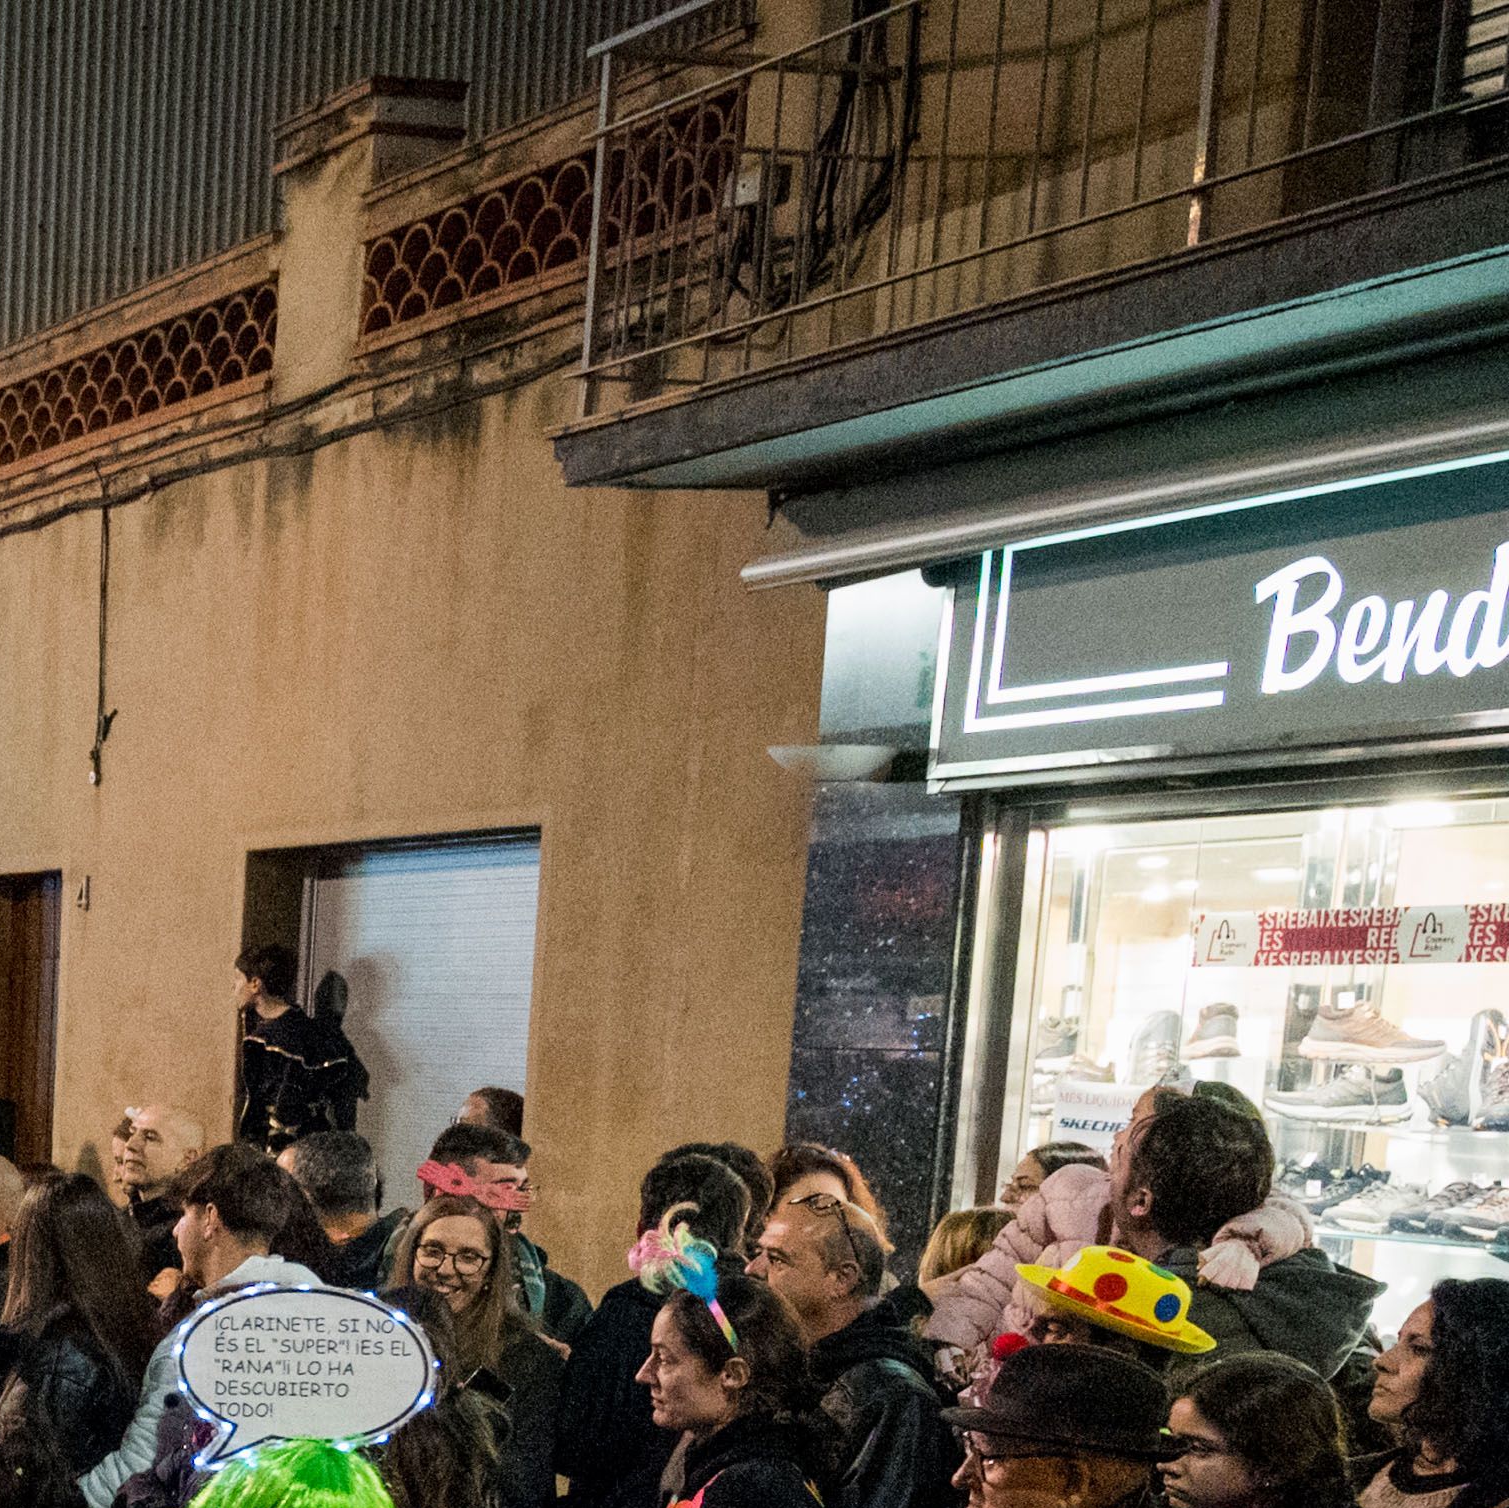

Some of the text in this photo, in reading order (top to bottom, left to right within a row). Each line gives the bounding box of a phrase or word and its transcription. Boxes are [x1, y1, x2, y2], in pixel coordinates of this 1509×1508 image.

[337, 1318, 360, 1334] SI
[366, 1318, 395, 1334] NO
[214, 1331, 239, 1353] ÉS
[244, 1337, 266, 1353] EL
[390, 1340, 412, 1356] EL
[296, 1360, 322, 1376] LO
[327, 1360, 355, 1376] HA
[214, 1380, 350, 1398] DESCUBIERTO
[214, 1401, 274, 1418] TODO!
